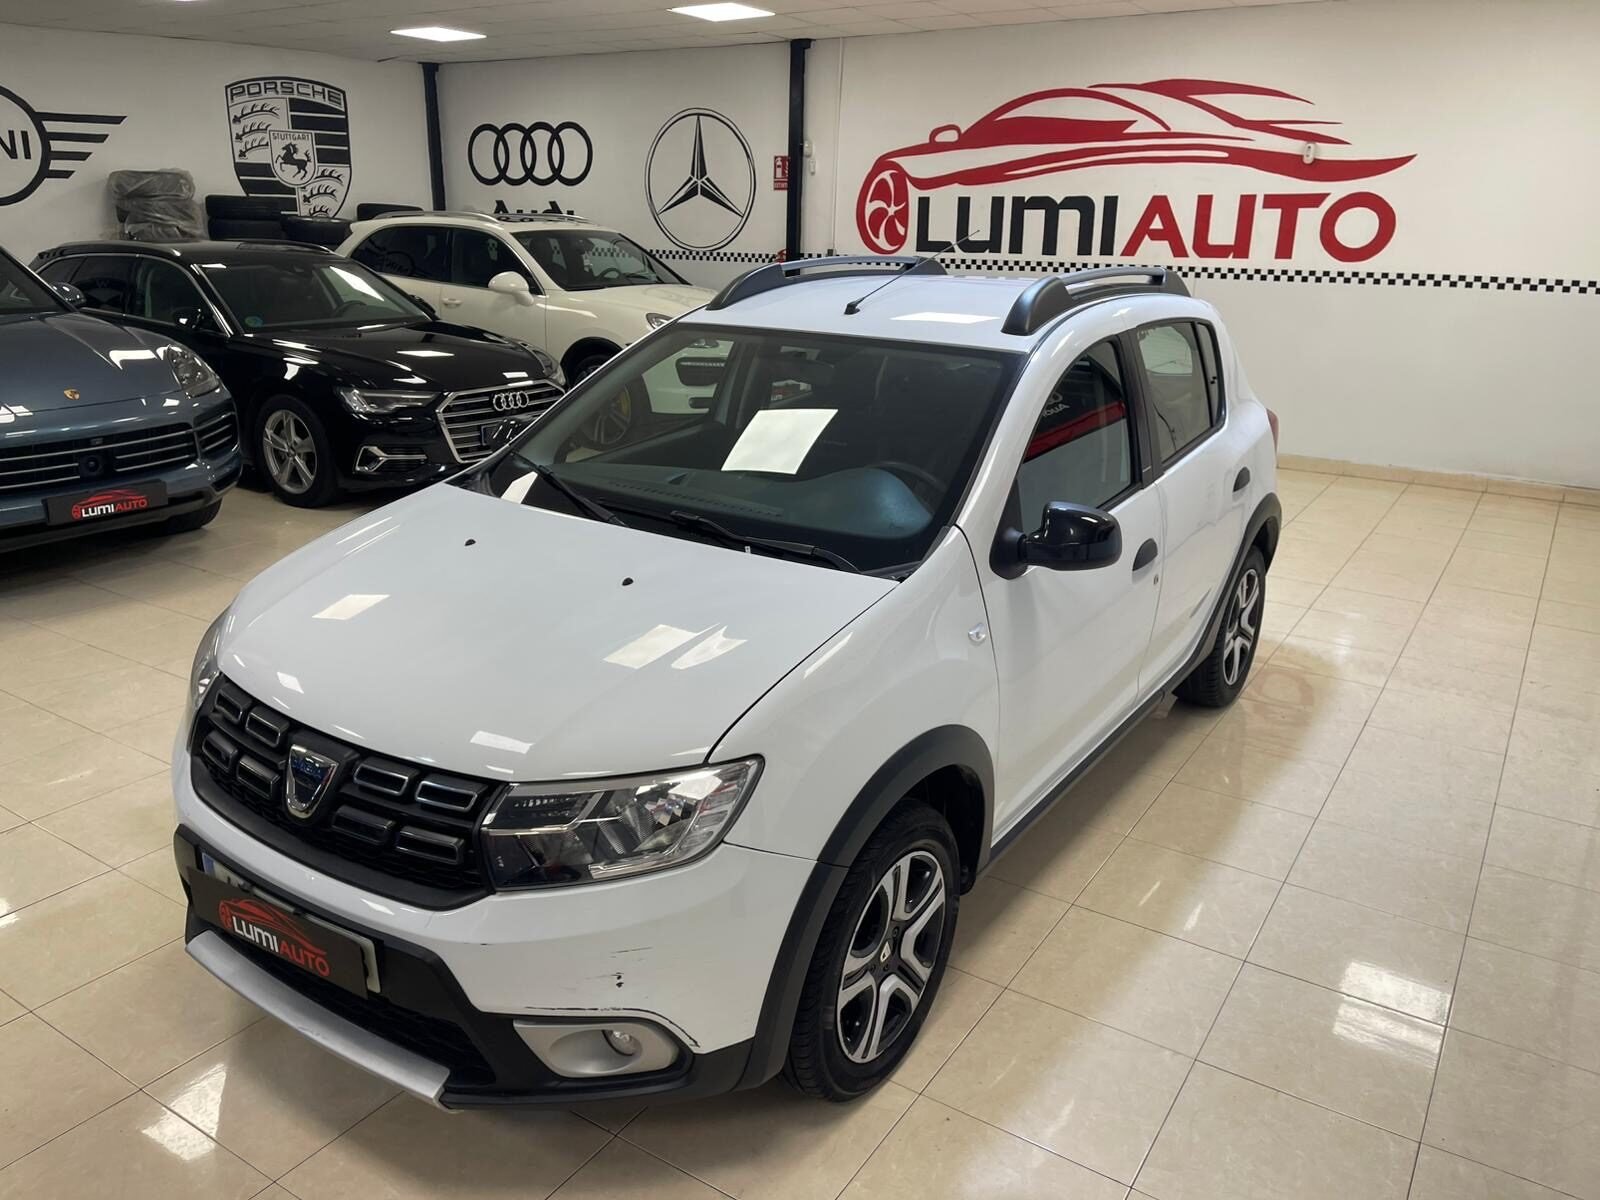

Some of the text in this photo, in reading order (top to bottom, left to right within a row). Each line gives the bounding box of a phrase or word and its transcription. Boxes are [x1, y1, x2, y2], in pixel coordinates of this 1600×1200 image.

[229, 81, 342, 105] PORSCHE
[272, 133, 310, 141] STUTTGART
[915, 192, 1397, 262] LUMIAUTO
[82, 500, 148, 518] LUMIAUTO
[231, 915, 331, 977] LUMIAUTO
